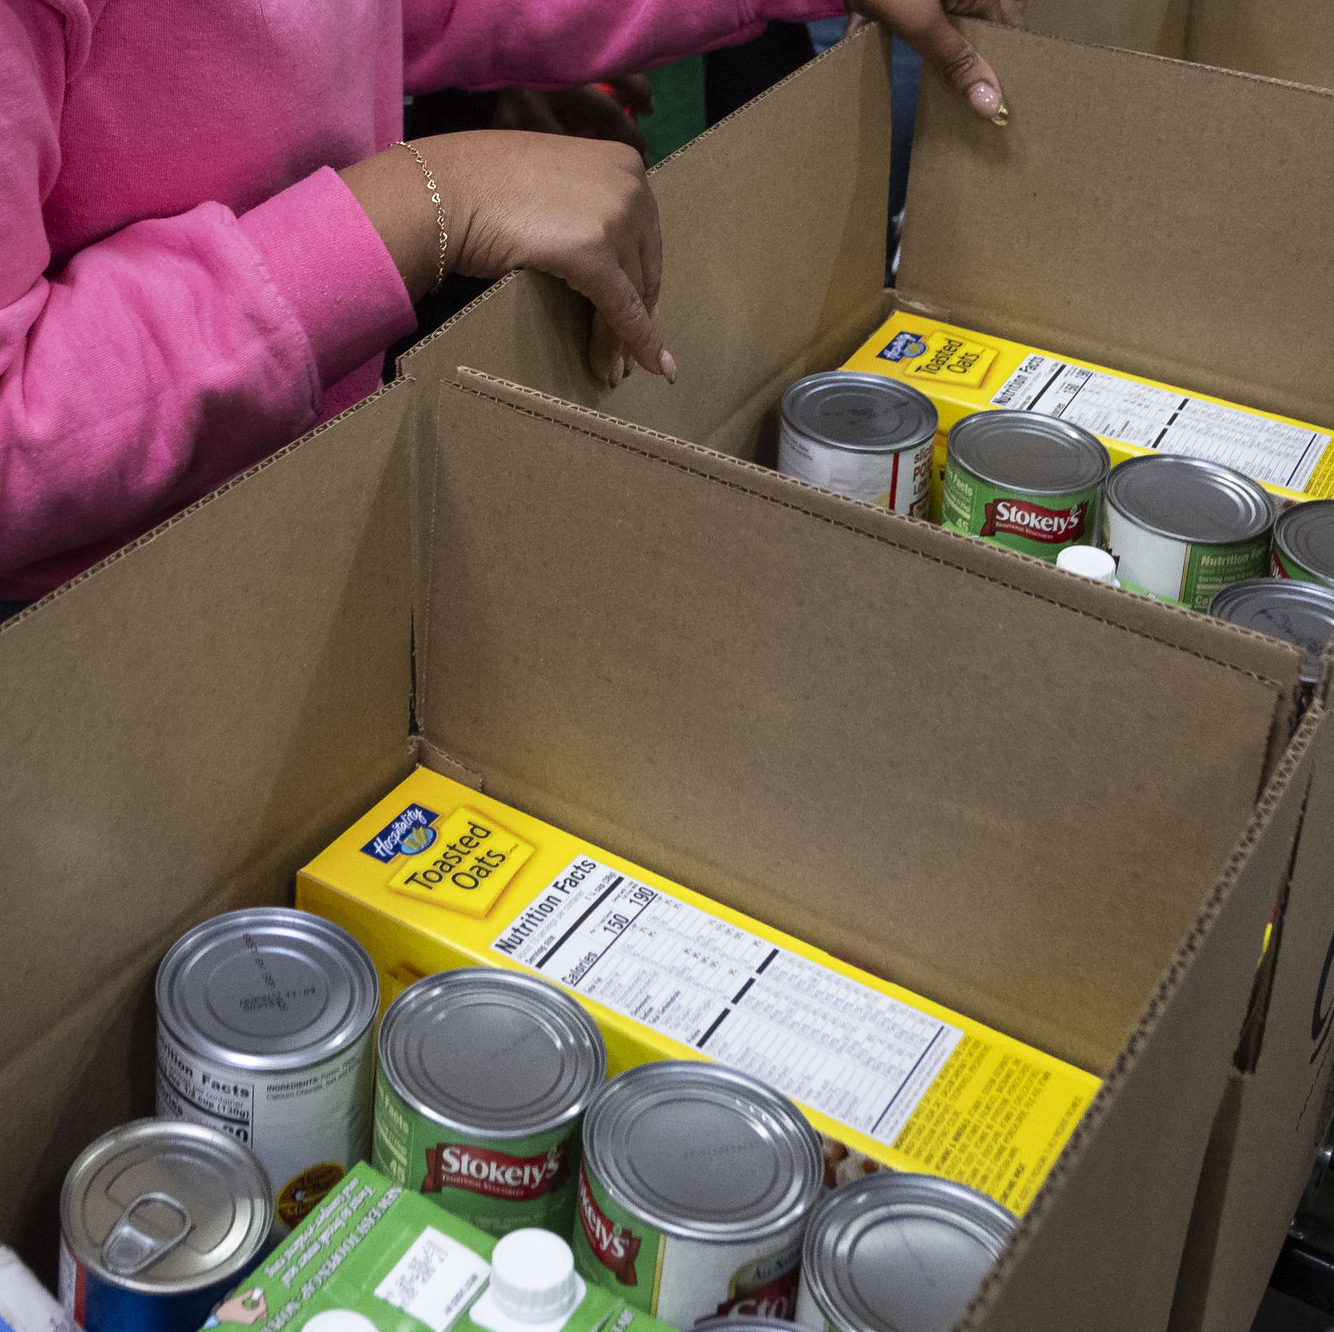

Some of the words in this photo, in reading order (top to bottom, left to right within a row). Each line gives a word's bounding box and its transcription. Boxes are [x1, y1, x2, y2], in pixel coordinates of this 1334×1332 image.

[915, 338, 964, 375] Toasted
[947, 352, 981, 374] Oats
[992, 374, 1026, 406] Nutrition
[1019, 356, 1045, 377] Facts
[995, 501, 1081, 535] Stokely's
[1201, 553, 1249, 566] Nutrition
[372, 808, 428, 857] Hospitality
[404, 821, 492, 890] Toasted
[451, 849, 507, 890] Oats
[494, 894, 562, 955] Nutrition
[552, 859, 597, 895] Facts
[562, 951, 598, 985] Calories
[603, 913, 629, 935] 150
[629, 886, 655, 908] 190
[201, 1073, 250, 1098] Facts
[442, 1146, 561, 1189] Stokely's
